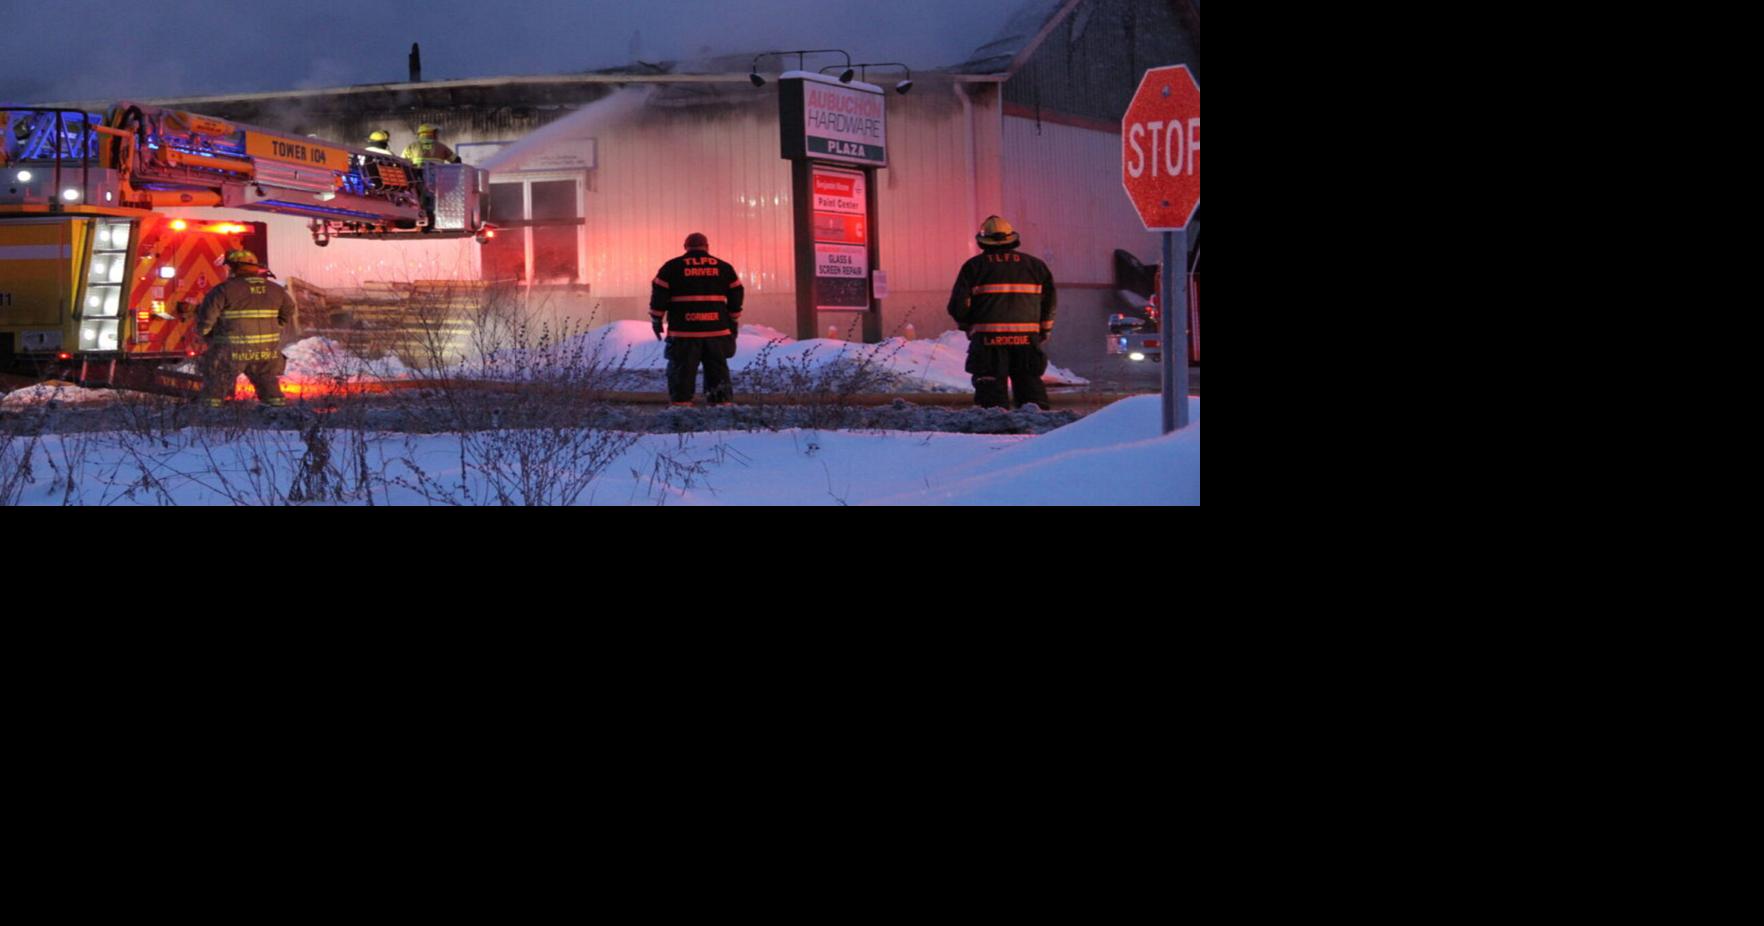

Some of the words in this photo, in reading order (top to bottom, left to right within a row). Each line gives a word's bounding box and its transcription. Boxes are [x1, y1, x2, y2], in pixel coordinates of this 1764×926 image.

[808, 90, 881, 116] AUBUCHON
[808, 108, 881, 138] HARDWARE
[272, 140, 307, 161] TOWER
[311, 147, 326, 165] 104
[828, 140, 866, 158] PLAZA
[1127, 117, 1200, 178] STOP
[818, 196, 836, 208] Paint
[837, 199, 859, 210] Center
[828, 254, 847, 264] GLASS
[684, 268, 718, 276] DRIVER
[819, 265, 841, 275] SCREEN
[842, 266, 862, 275] REPAIR
